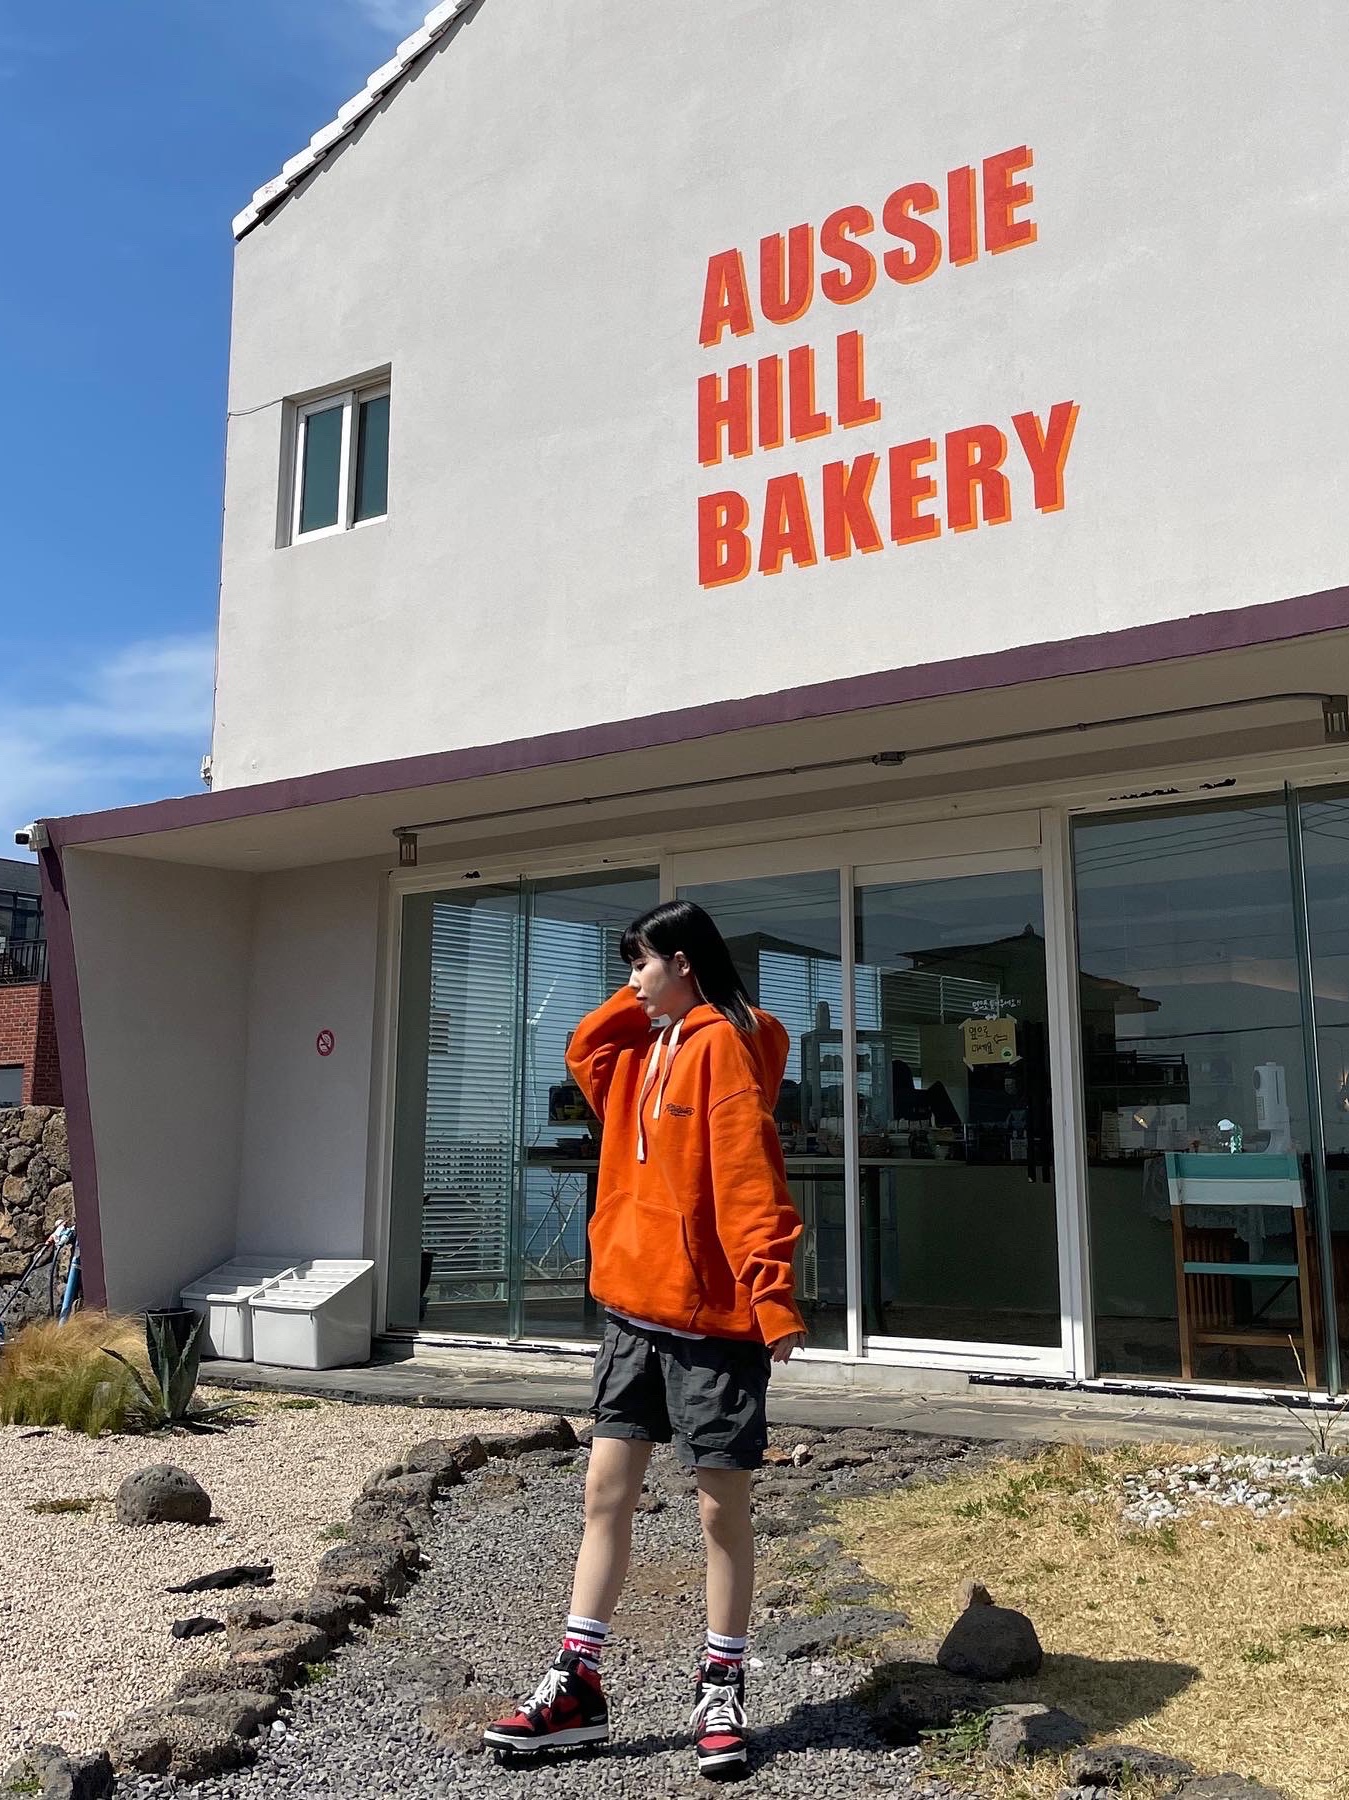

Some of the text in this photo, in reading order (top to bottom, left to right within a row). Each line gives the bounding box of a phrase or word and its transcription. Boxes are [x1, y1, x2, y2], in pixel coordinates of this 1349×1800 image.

[698, 144, 1037, 348] AUSSIE
[698, 330, 881, 467] HILL
[698, 400, 1080, 589] BAKERY
[968, 1026, 992, 1040] 옆으로
[971, 1041, 994, 1055] 미세요
